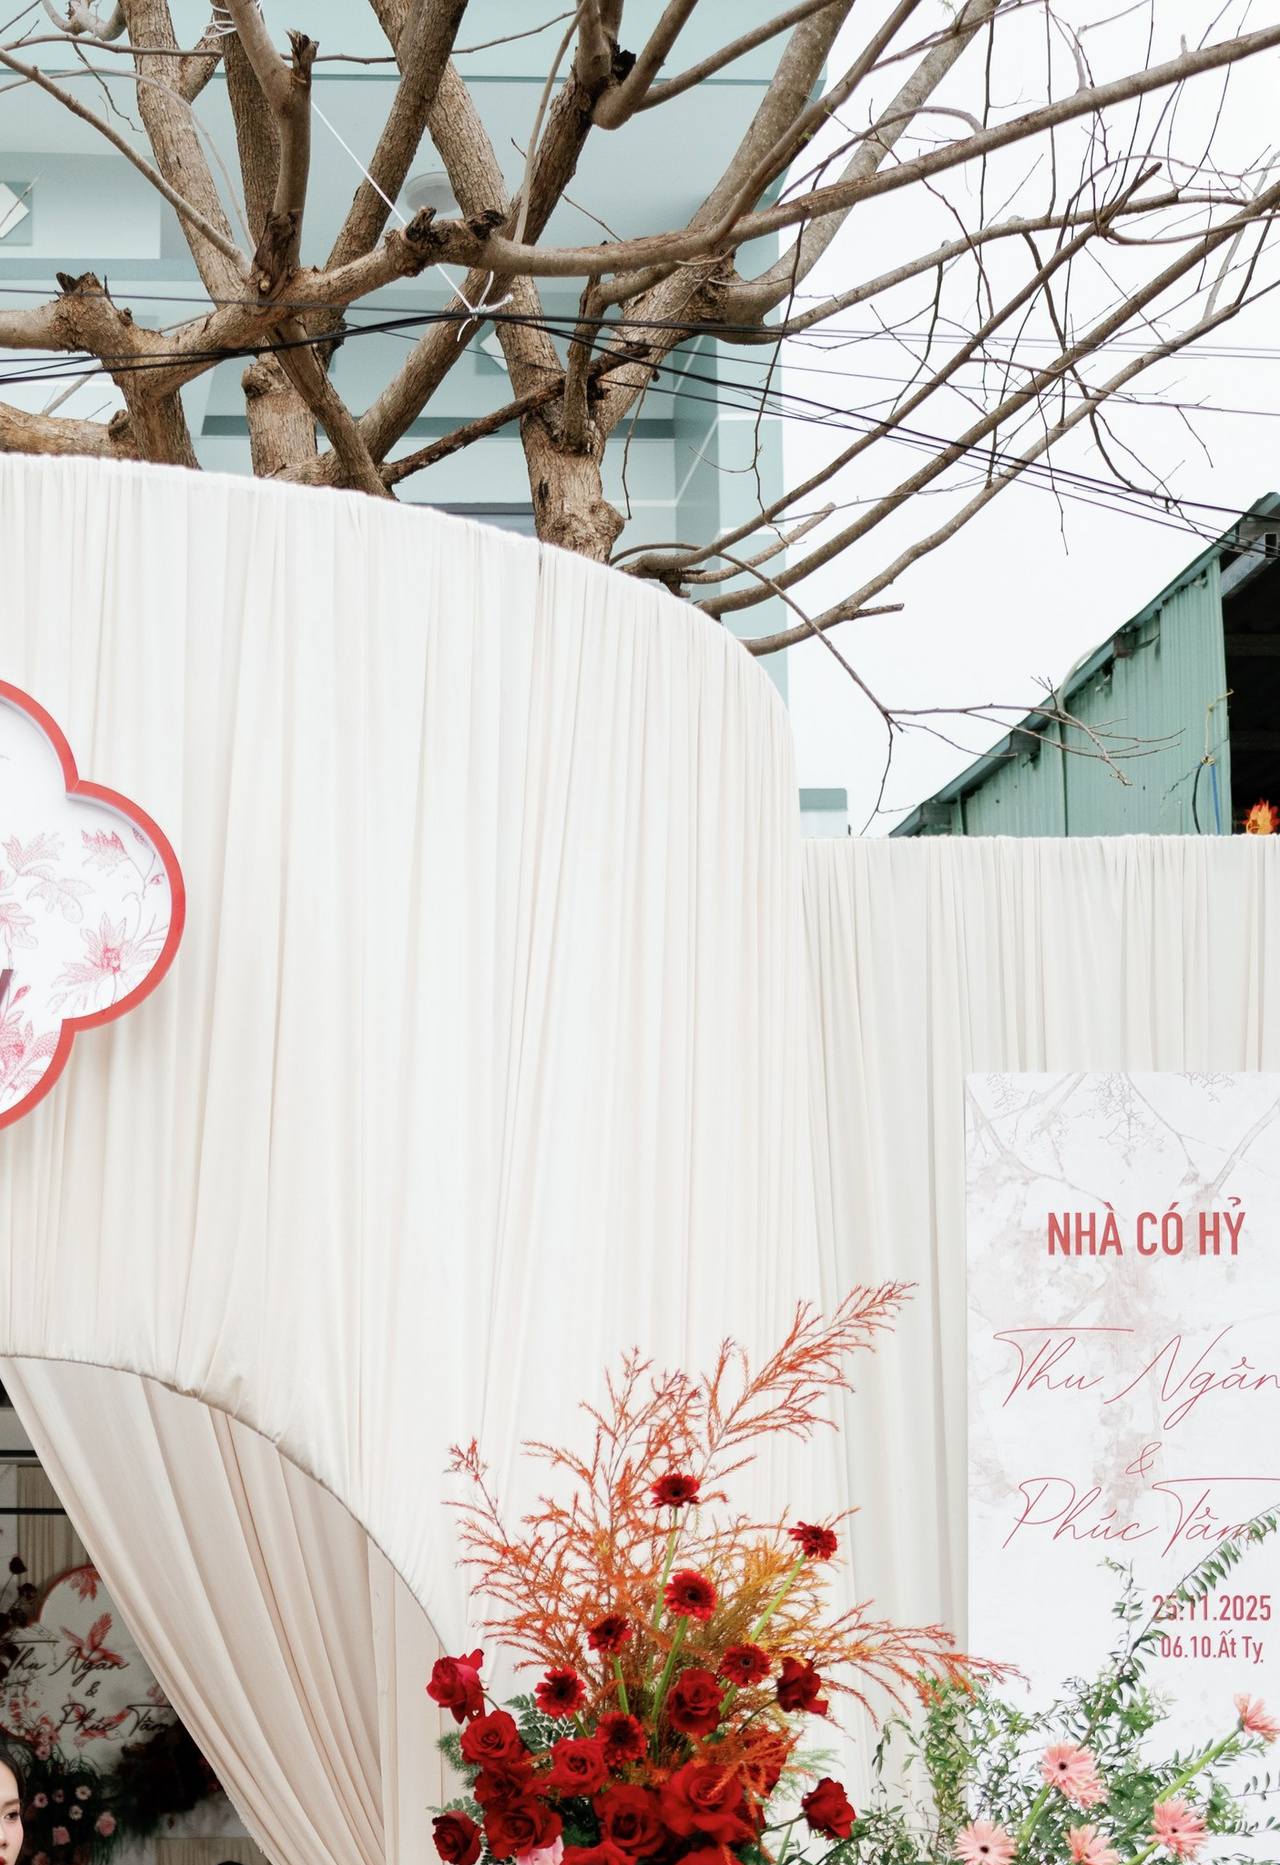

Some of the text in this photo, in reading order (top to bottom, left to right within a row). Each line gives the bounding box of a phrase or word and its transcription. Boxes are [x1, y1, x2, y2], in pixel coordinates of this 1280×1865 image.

[1047, 1196, 1247, 1257] NHÀ CÓ HỶ
[993, 1325, 1280, 1431] Thu Ngân
[1125, 1441, 1163, 1479] &
[1002, 1477, 1280, 1558] Phúc Tâm
[1152, 1594, 1271, 1622] 25.11.2025
[1160, 1629, 1264, 1665] 06.10.Ất Tỵ
[85, 1681, 100, 1697] &
